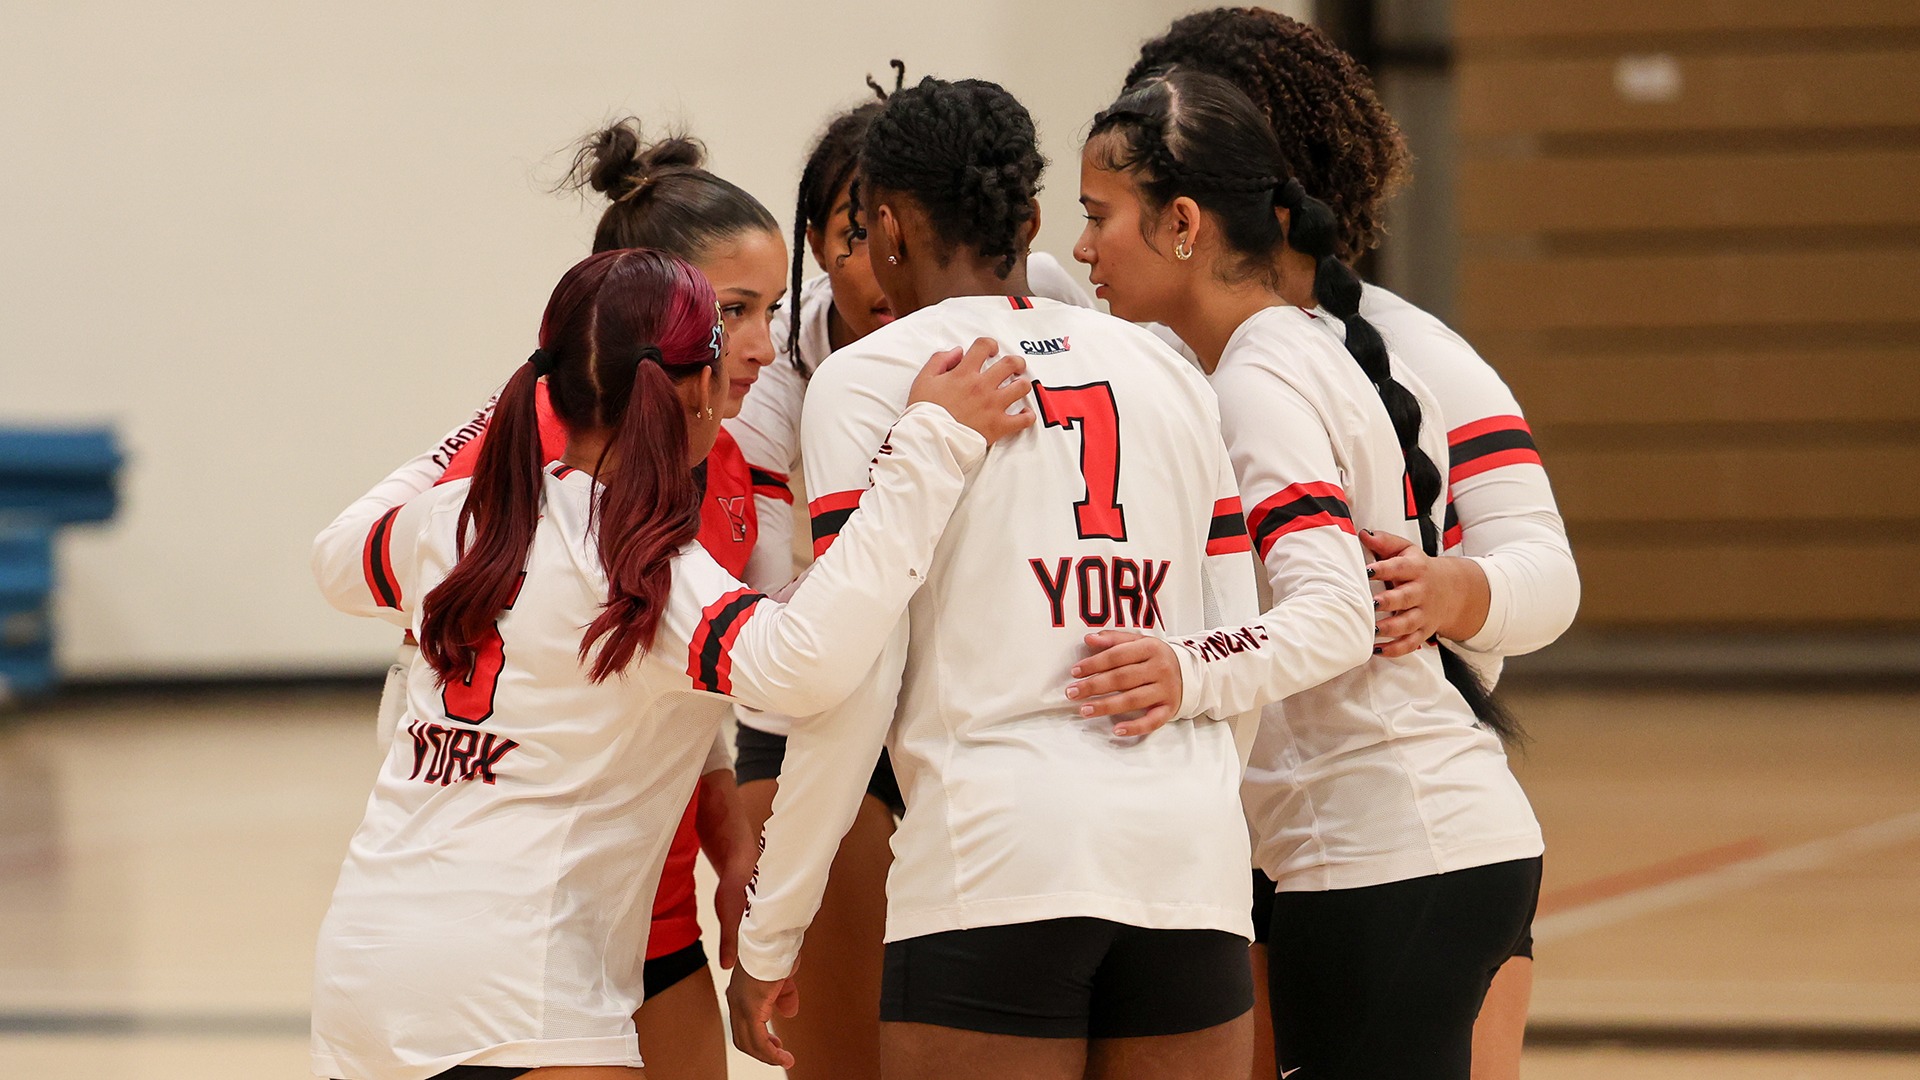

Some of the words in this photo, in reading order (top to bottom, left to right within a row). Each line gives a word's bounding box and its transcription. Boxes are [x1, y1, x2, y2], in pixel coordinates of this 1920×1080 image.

[1032, 379, 1128, 542] 7
[1028, 556, 1171, 631] YORK
[407, 719, 520, 786] YORK
